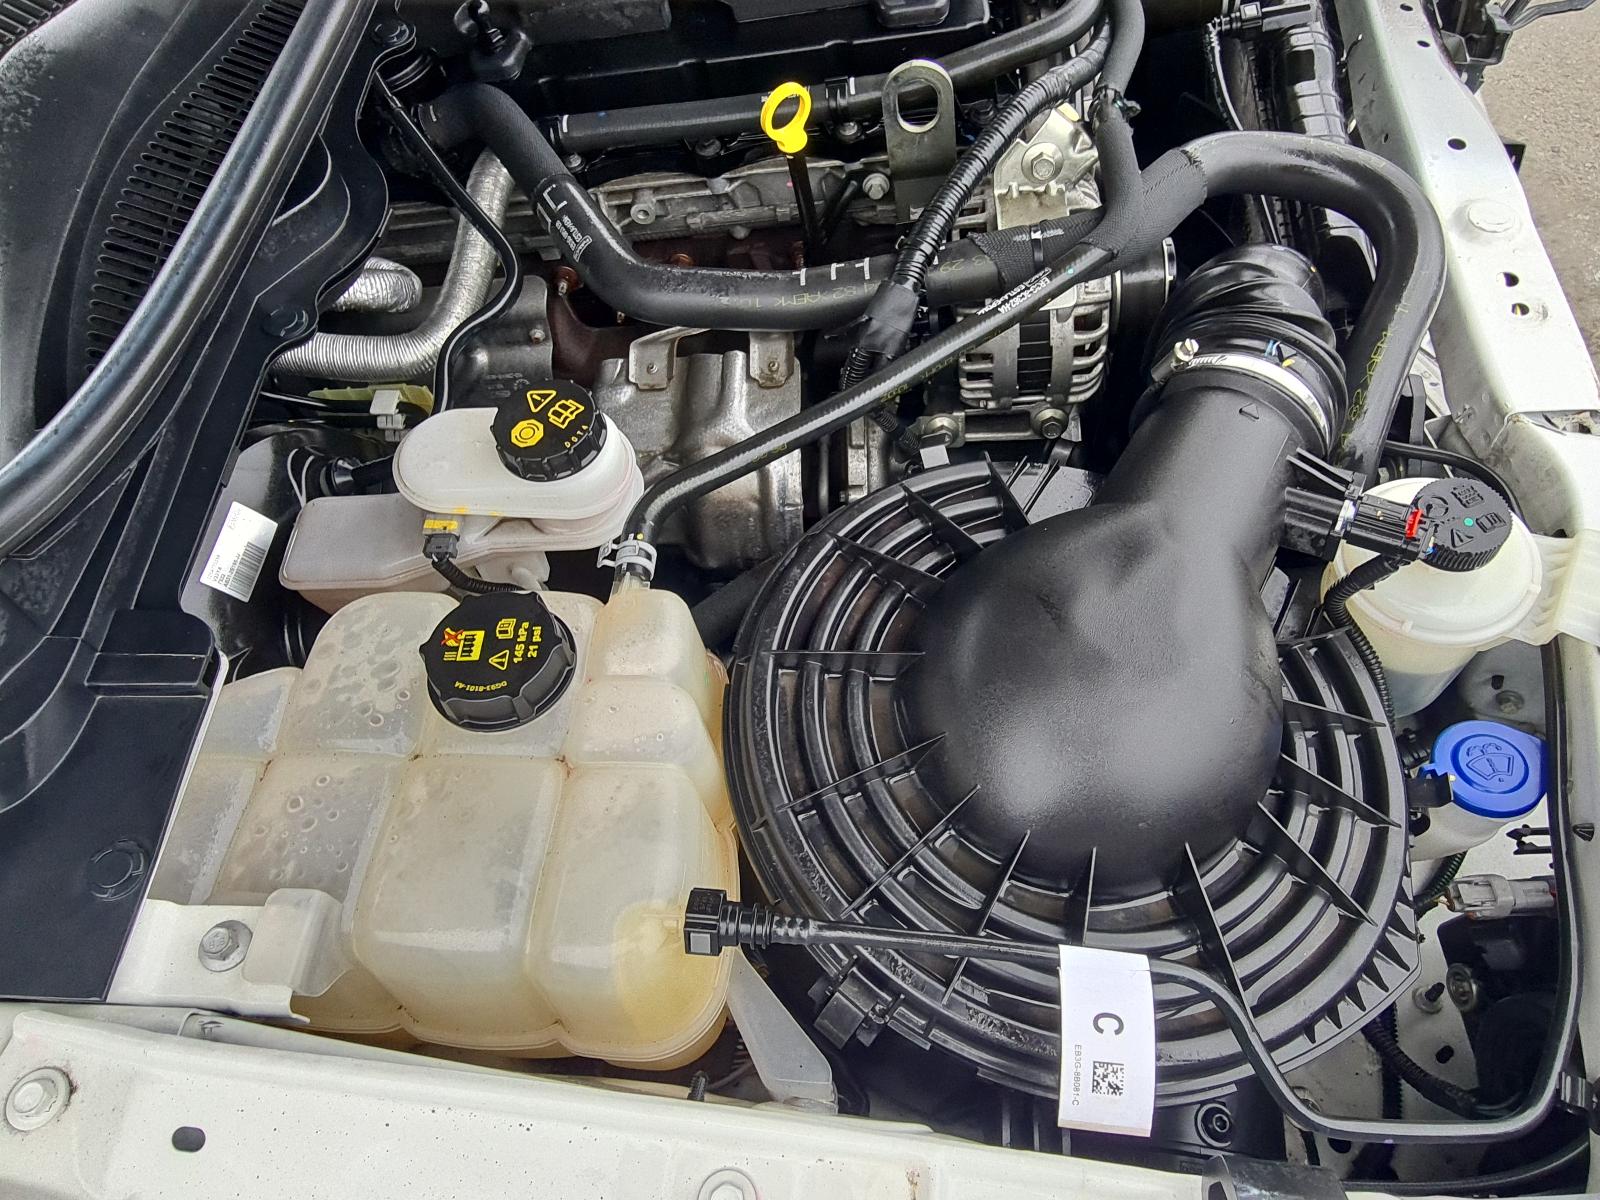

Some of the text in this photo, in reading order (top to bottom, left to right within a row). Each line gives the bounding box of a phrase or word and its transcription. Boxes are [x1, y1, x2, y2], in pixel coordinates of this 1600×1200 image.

[513, 622, 530, 664] 145 kPa
[528, 626, 543, 658] 21 psi
[1093, 1012, 1125, 1036] C
[1072, 1044, 1082, 1106] EB3G-8B081-C
